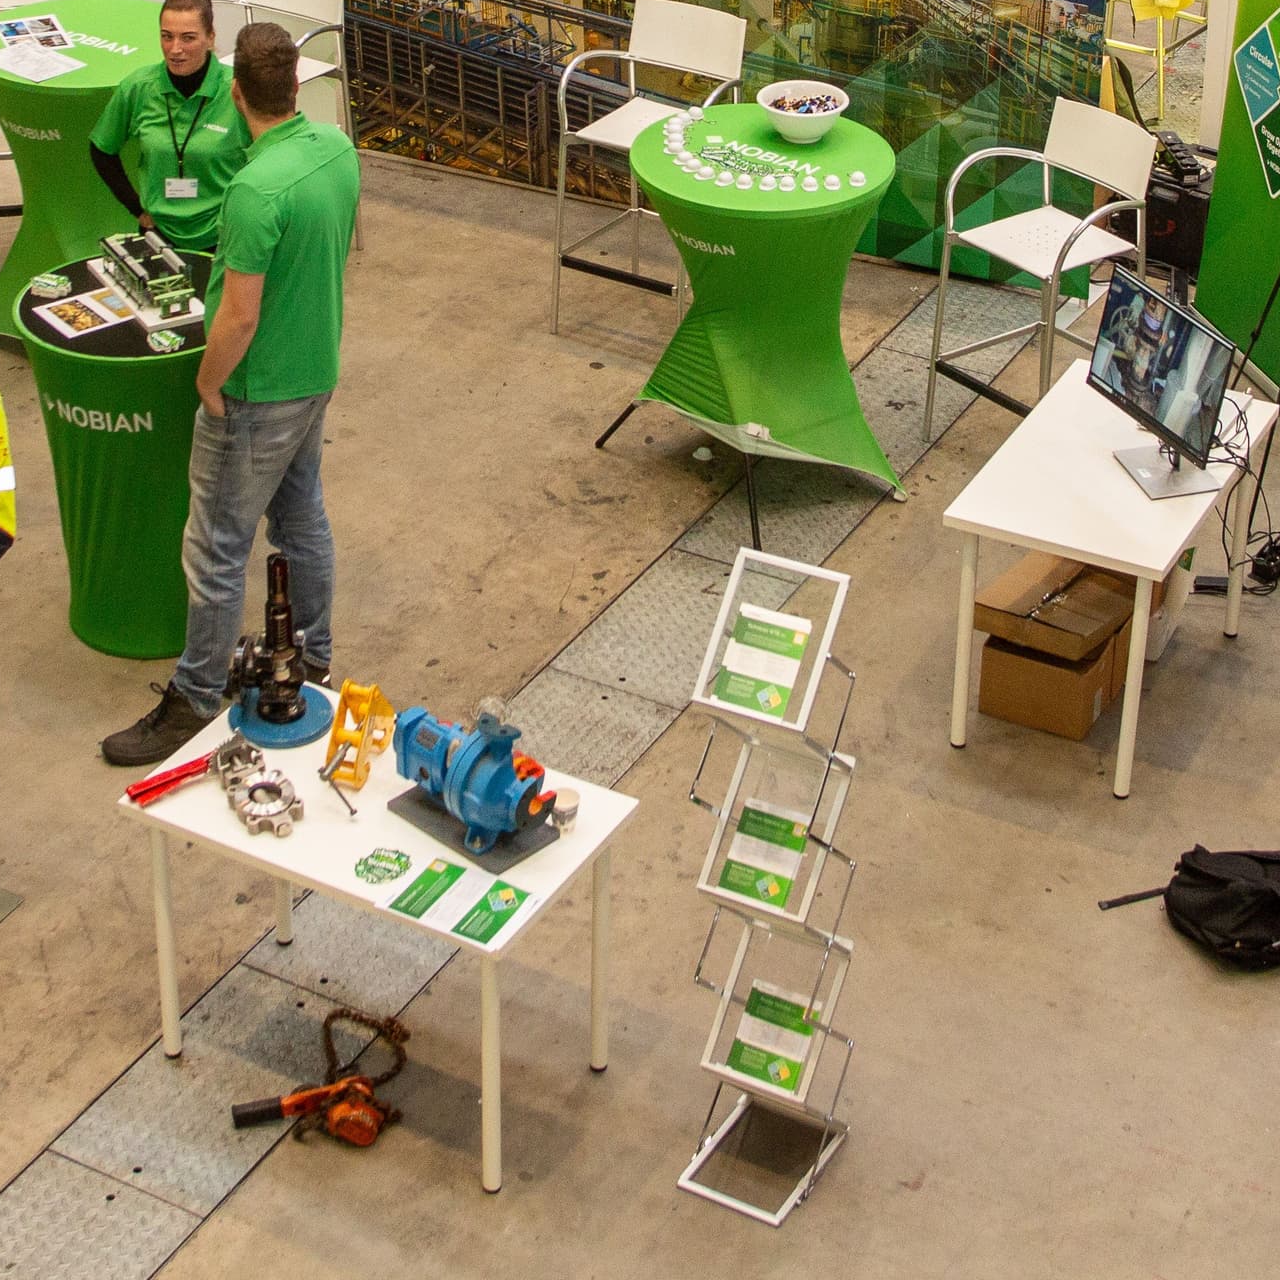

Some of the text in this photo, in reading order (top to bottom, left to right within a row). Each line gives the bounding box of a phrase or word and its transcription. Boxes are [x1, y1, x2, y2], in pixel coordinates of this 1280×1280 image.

[1249, 45, 1275, 70] Circular
[8, 121, 62, 142] NOBIAN
[724, 139, 821, 177] NOBIAN
[681, 233, 736, 257] NOBIAN
[56, 398, 153, 433] NOBIAN
